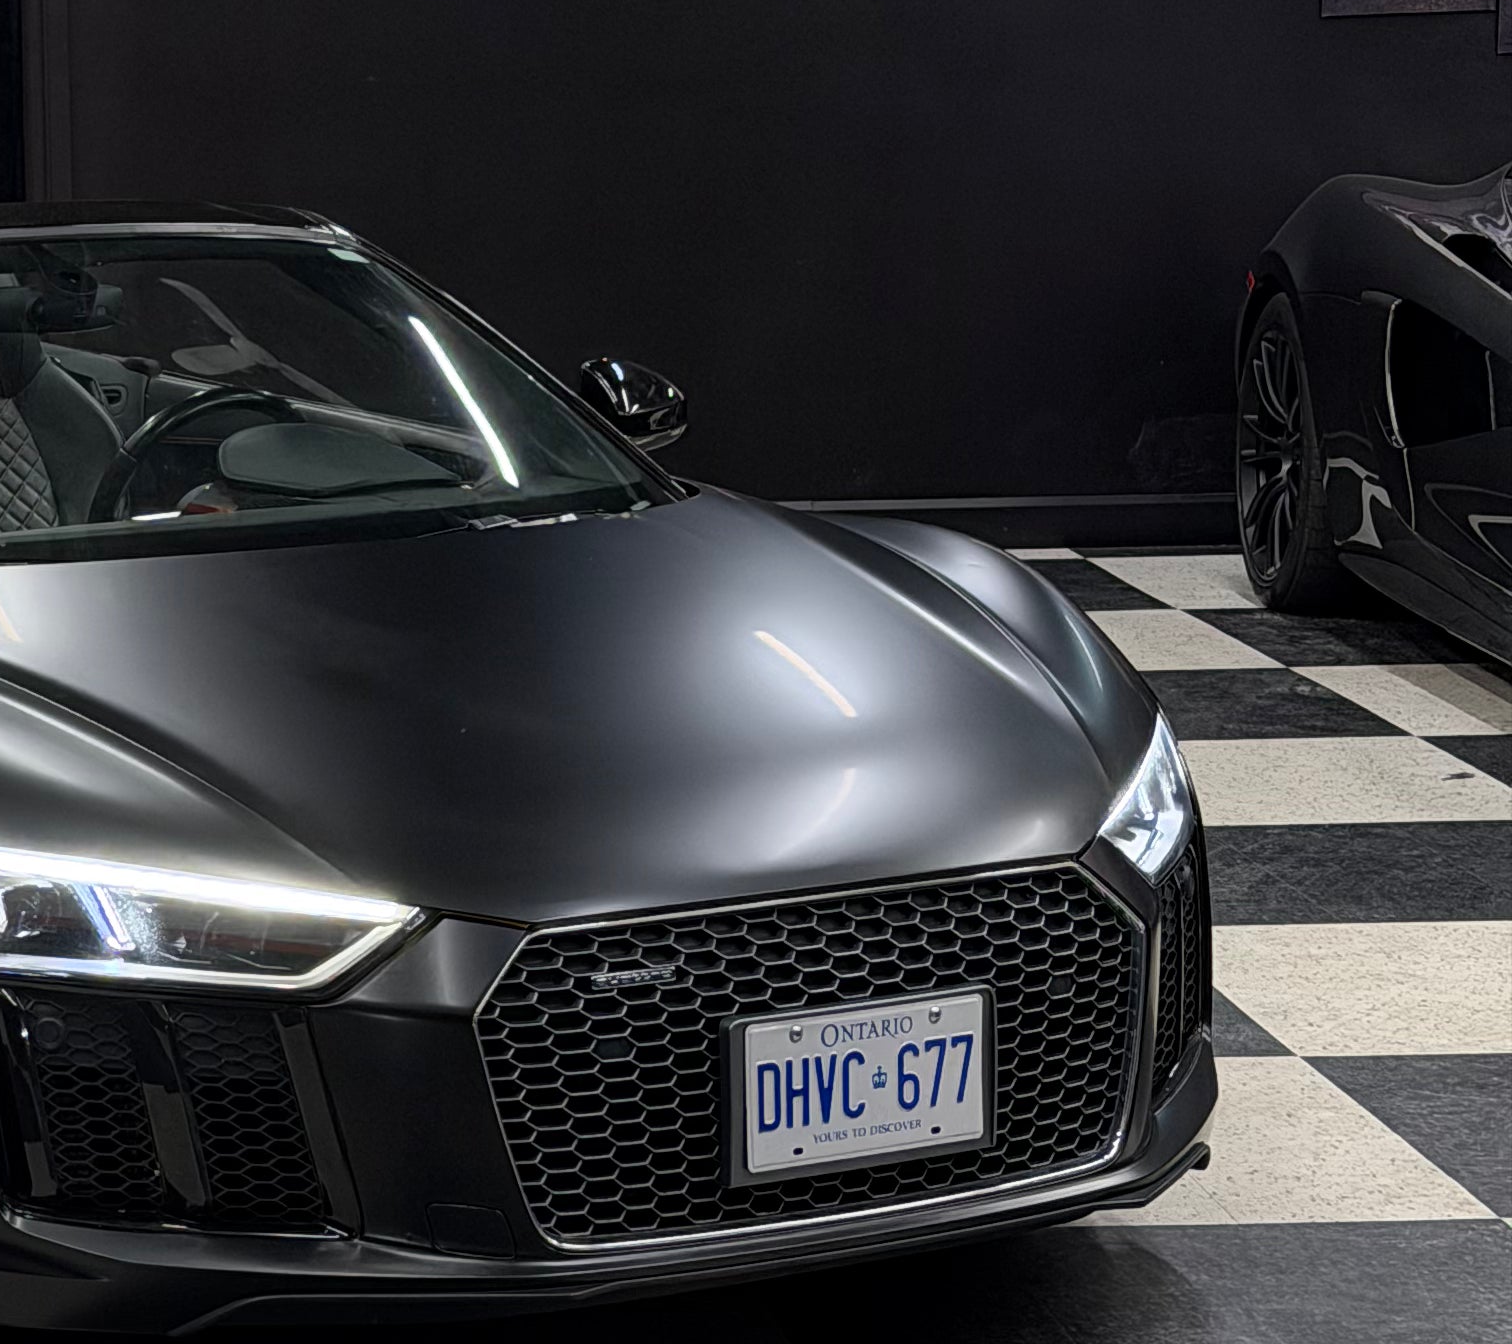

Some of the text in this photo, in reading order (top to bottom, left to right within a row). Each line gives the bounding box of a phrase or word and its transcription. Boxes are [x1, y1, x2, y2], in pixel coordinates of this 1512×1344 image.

[756, 1033, 974, 1133] DHVC 677
[812, 1119, 922, 1144] YOURS TO DISCOVER
